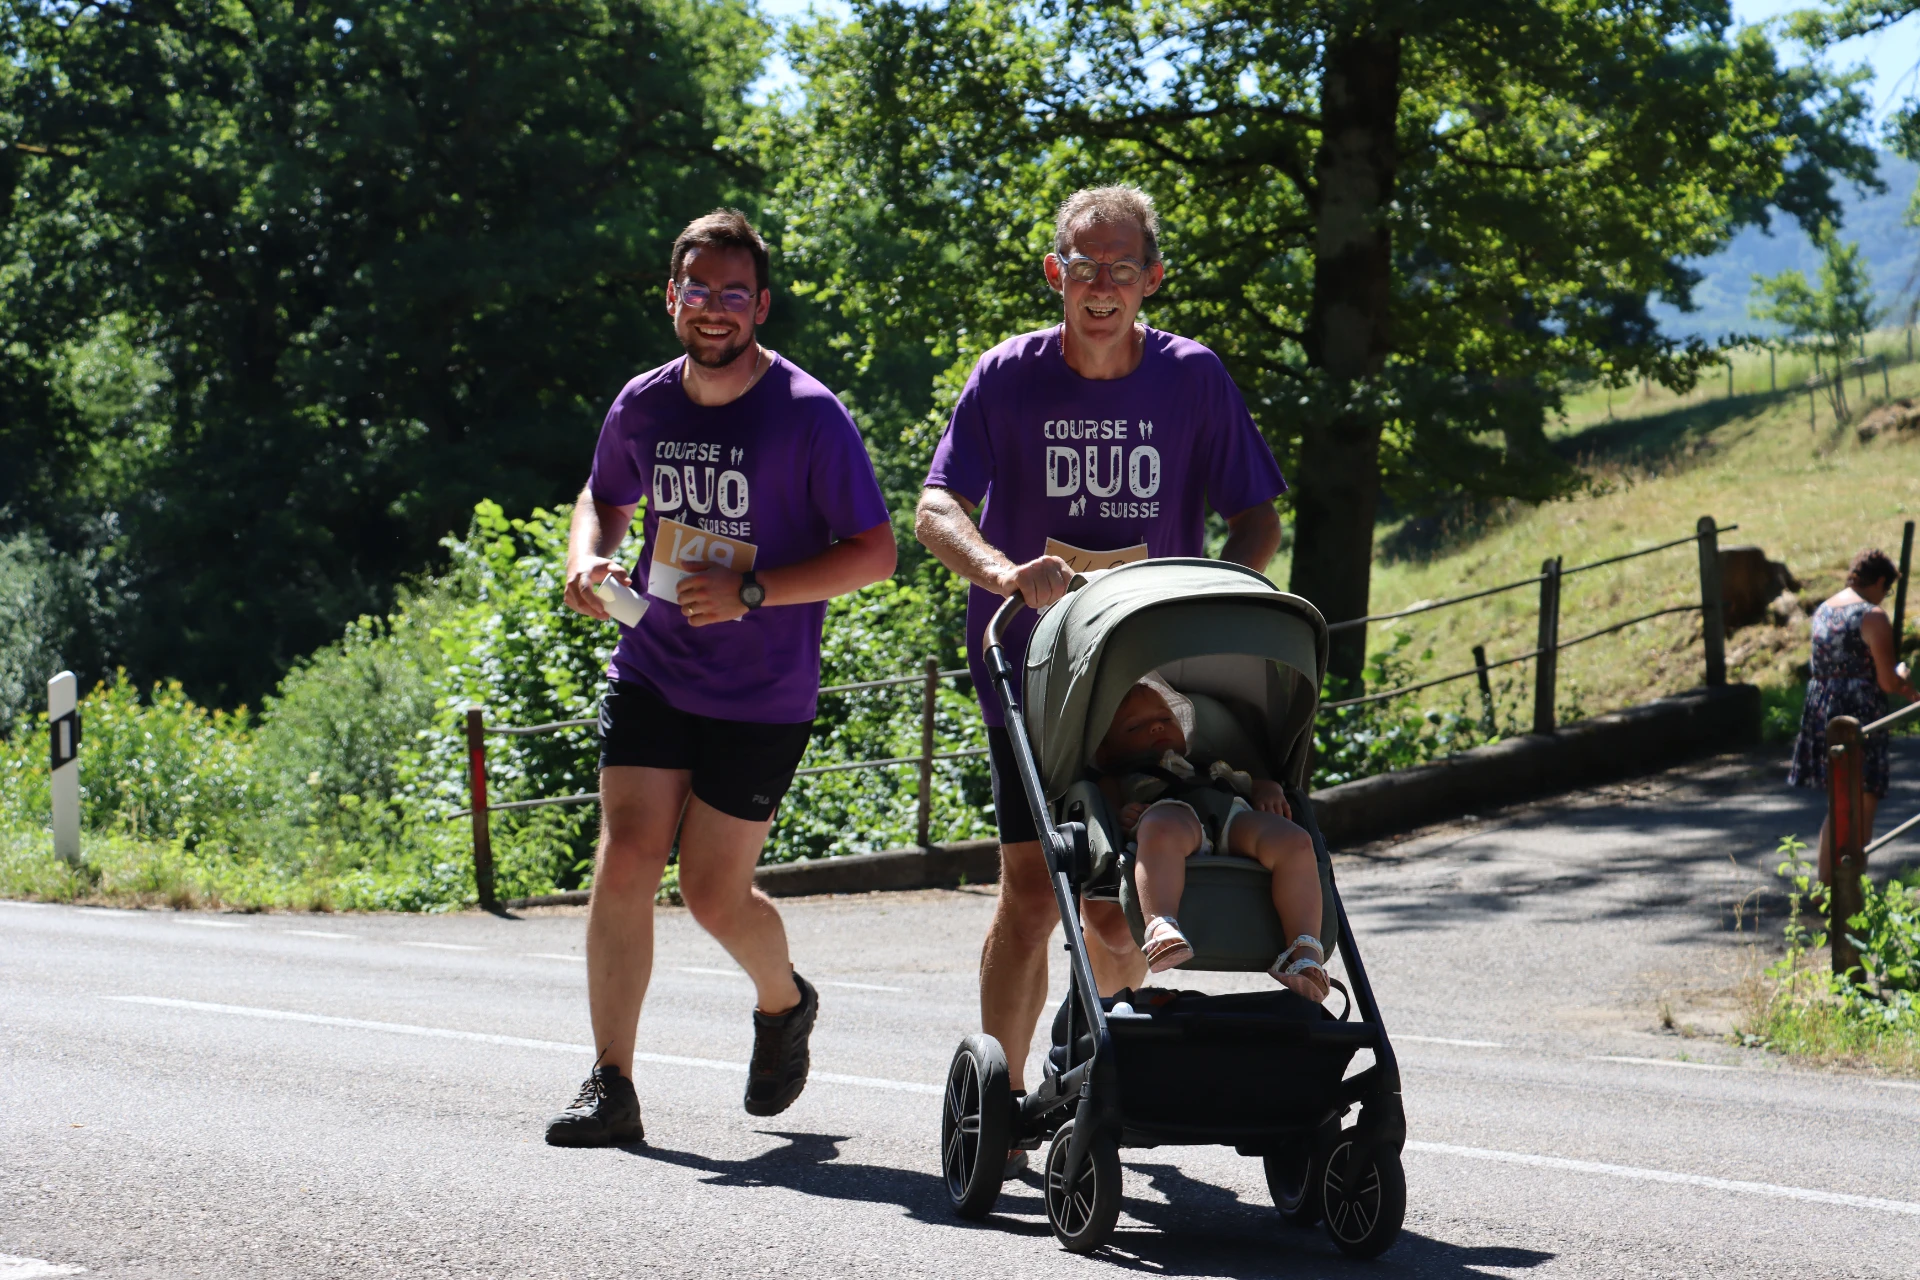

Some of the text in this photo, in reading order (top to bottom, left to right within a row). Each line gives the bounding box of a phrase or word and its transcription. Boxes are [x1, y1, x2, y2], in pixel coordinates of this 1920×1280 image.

[1044, 419, 1128, 440] COURSE
[655, 441, 722, 463] COURSE
[1046, 445, 1161, 499] DUO
[652, 464, 749, 519] DUO
[1099, 501, 1160, 519] SUISSE
[697, 517, 751, 537] SUISSE
[670, 528, 735, 569] 149
[752, 794, 770, 805] FILA
